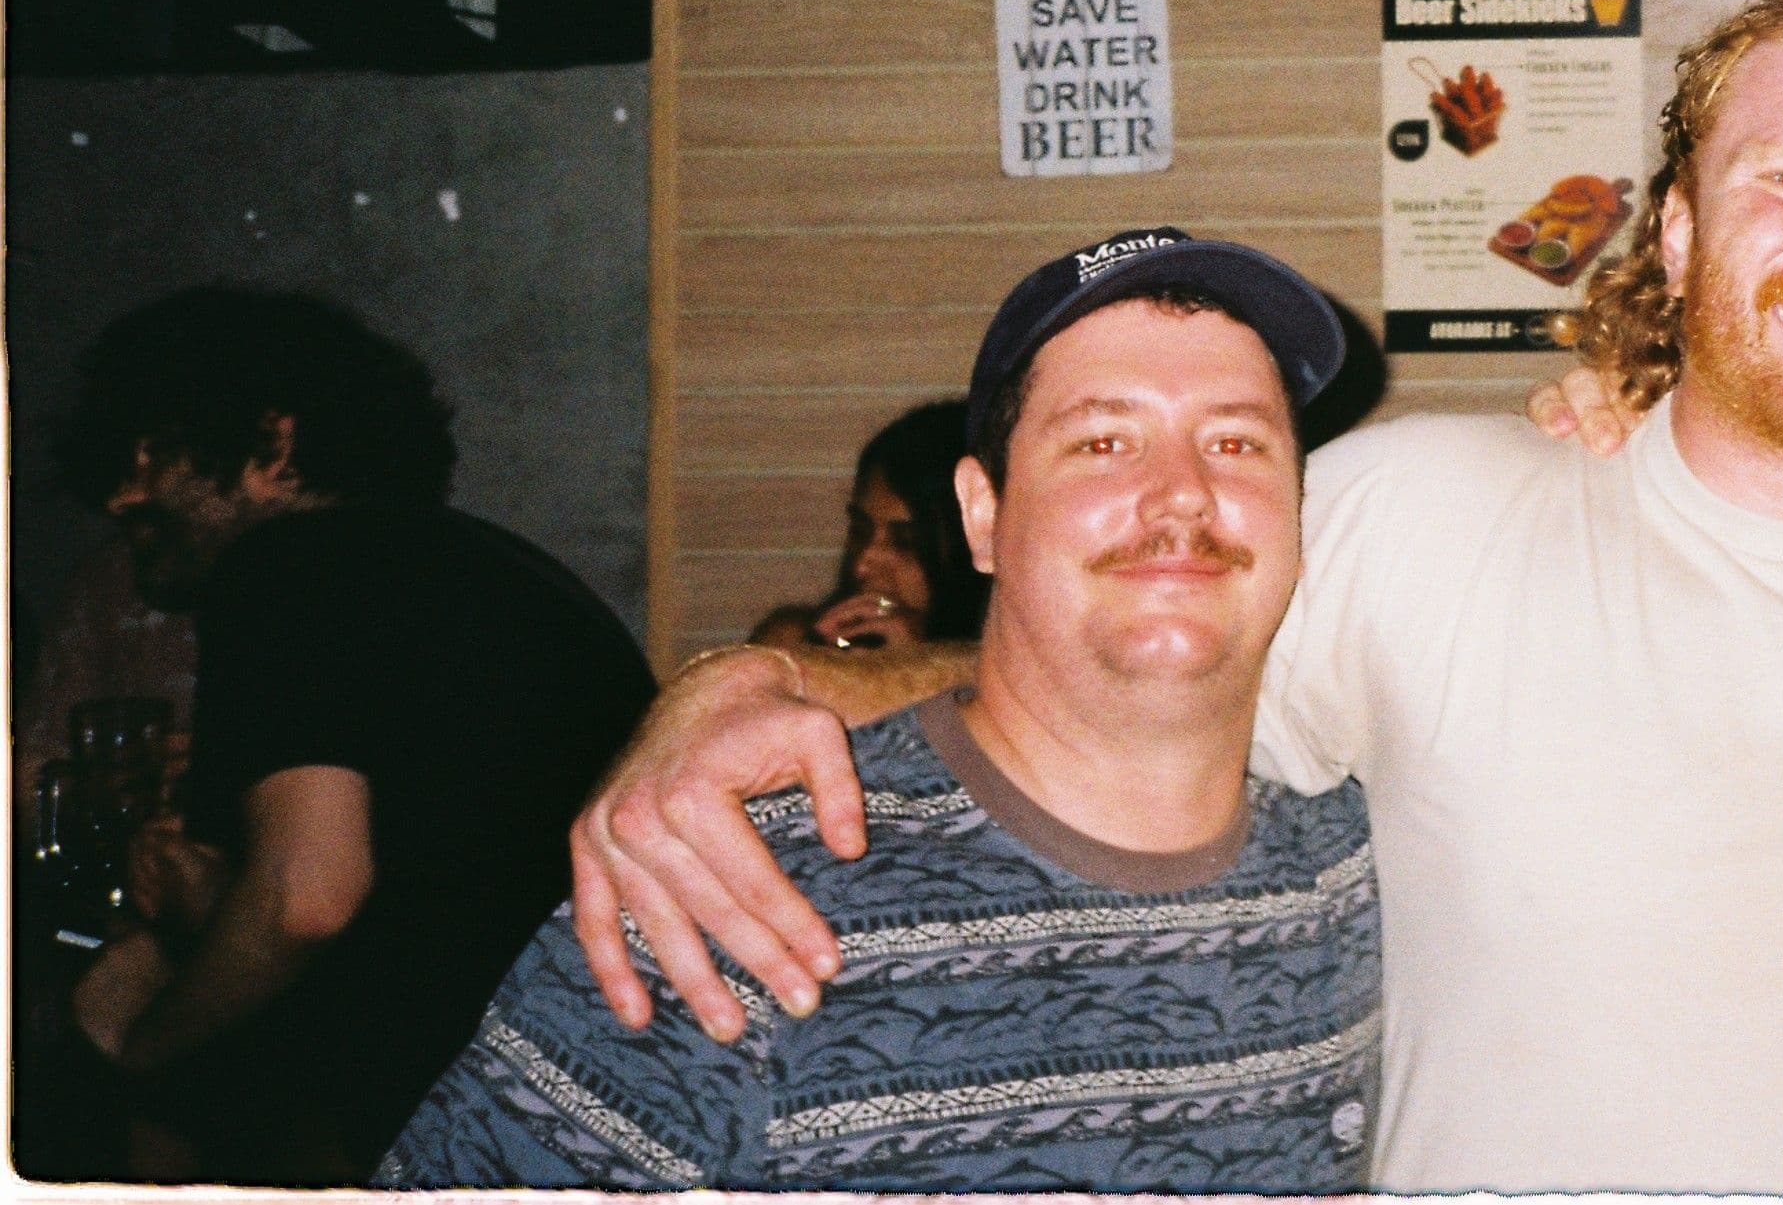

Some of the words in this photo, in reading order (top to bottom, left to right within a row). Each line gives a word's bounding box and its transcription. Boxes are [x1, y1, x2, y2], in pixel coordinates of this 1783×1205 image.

[1014, 35, 1158, 71] WATER
[1024, 78, 1150, 114] DRINK
[1020, 117, 1157, 161] BEER
[1074, 234, 1175, 268] Monte
